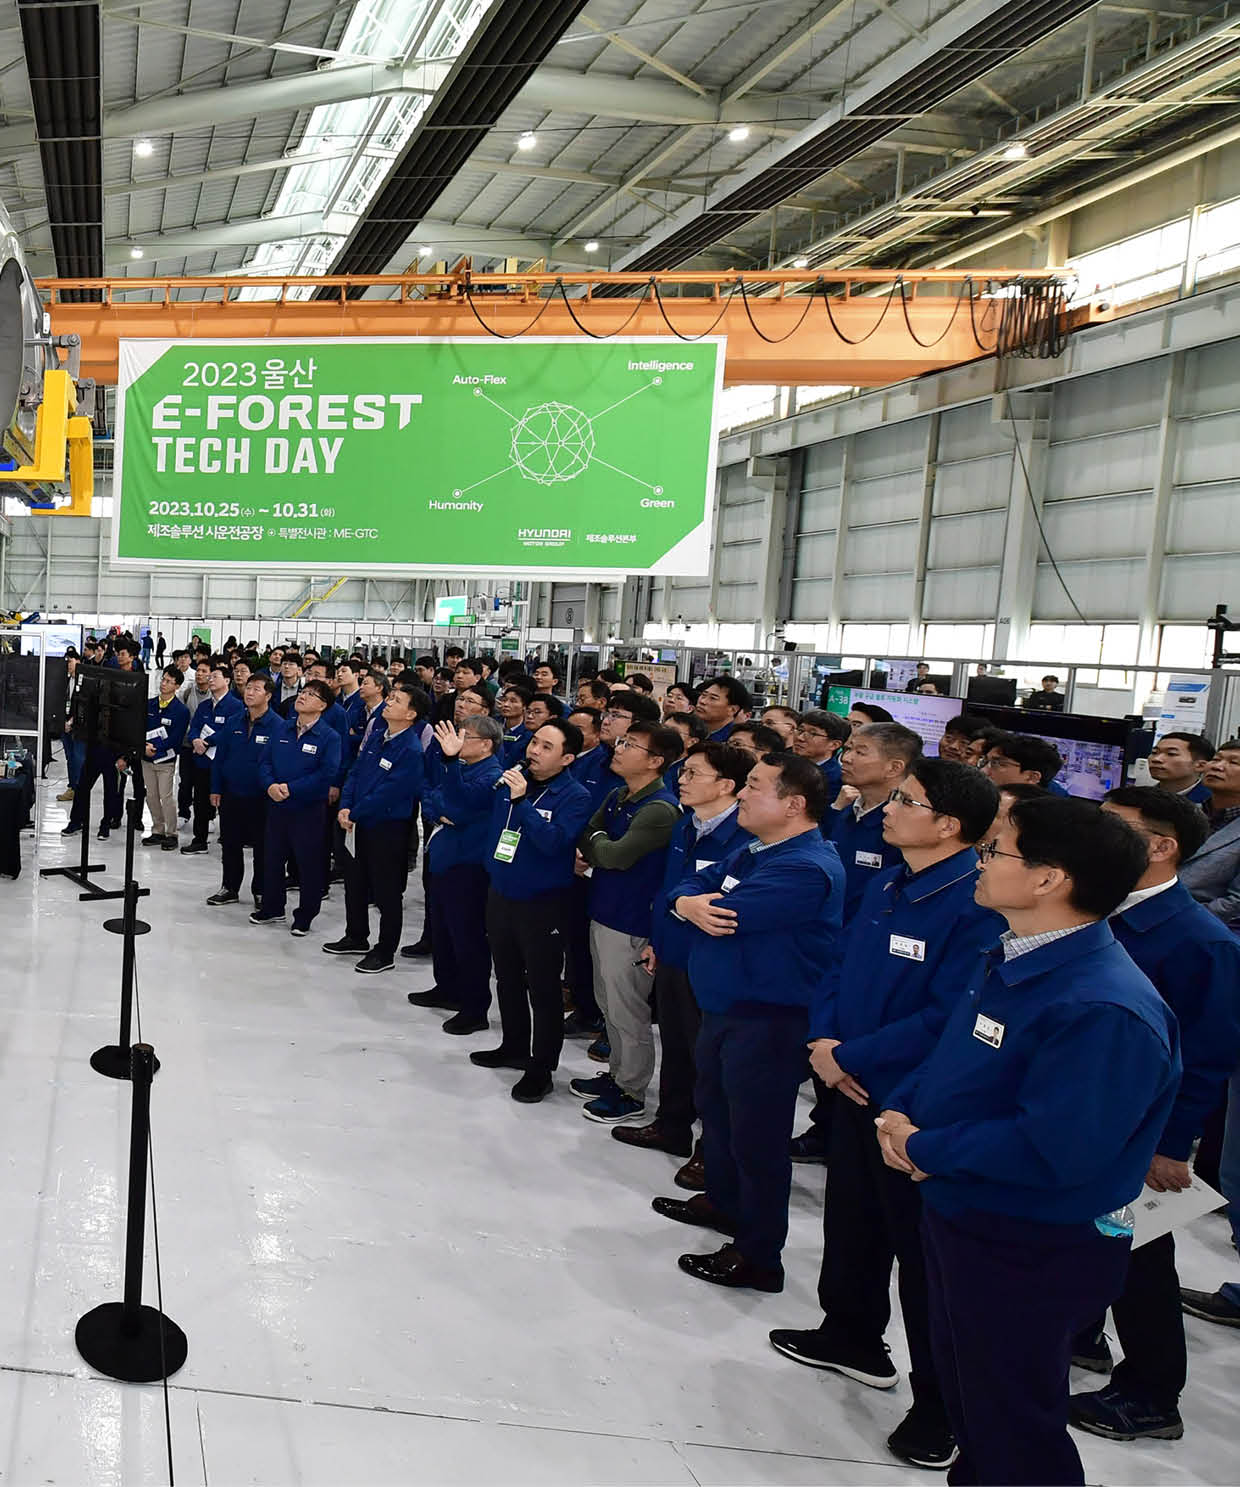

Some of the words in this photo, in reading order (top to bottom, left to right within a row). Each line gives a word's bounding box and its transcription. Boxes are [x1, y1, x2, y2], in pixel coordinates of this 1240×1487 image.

[182, 362, 257, 387] 2023
[261, 357, 318, 390] 울산
[627, 360, 694, 373] Intelligence
[452, 374, 508, 385] Auto-Flex
[152, 394, 423, 431] E-FOREST
[151, 436, 251, 474] TECH
[264, 437, 345, 474] DAY
[428, 499, 484, 513] Humanity
[640, 498, 675, 508] Green
[147, 523, 204, 538] 제조솔루션
[206, 525, 264, 540] 시운전공장
[278, 528, 327, 540] 특별전시관
[333, 528, 379, 539] ME-GTC
[518, 528, 571, 538] HYUNDAI
